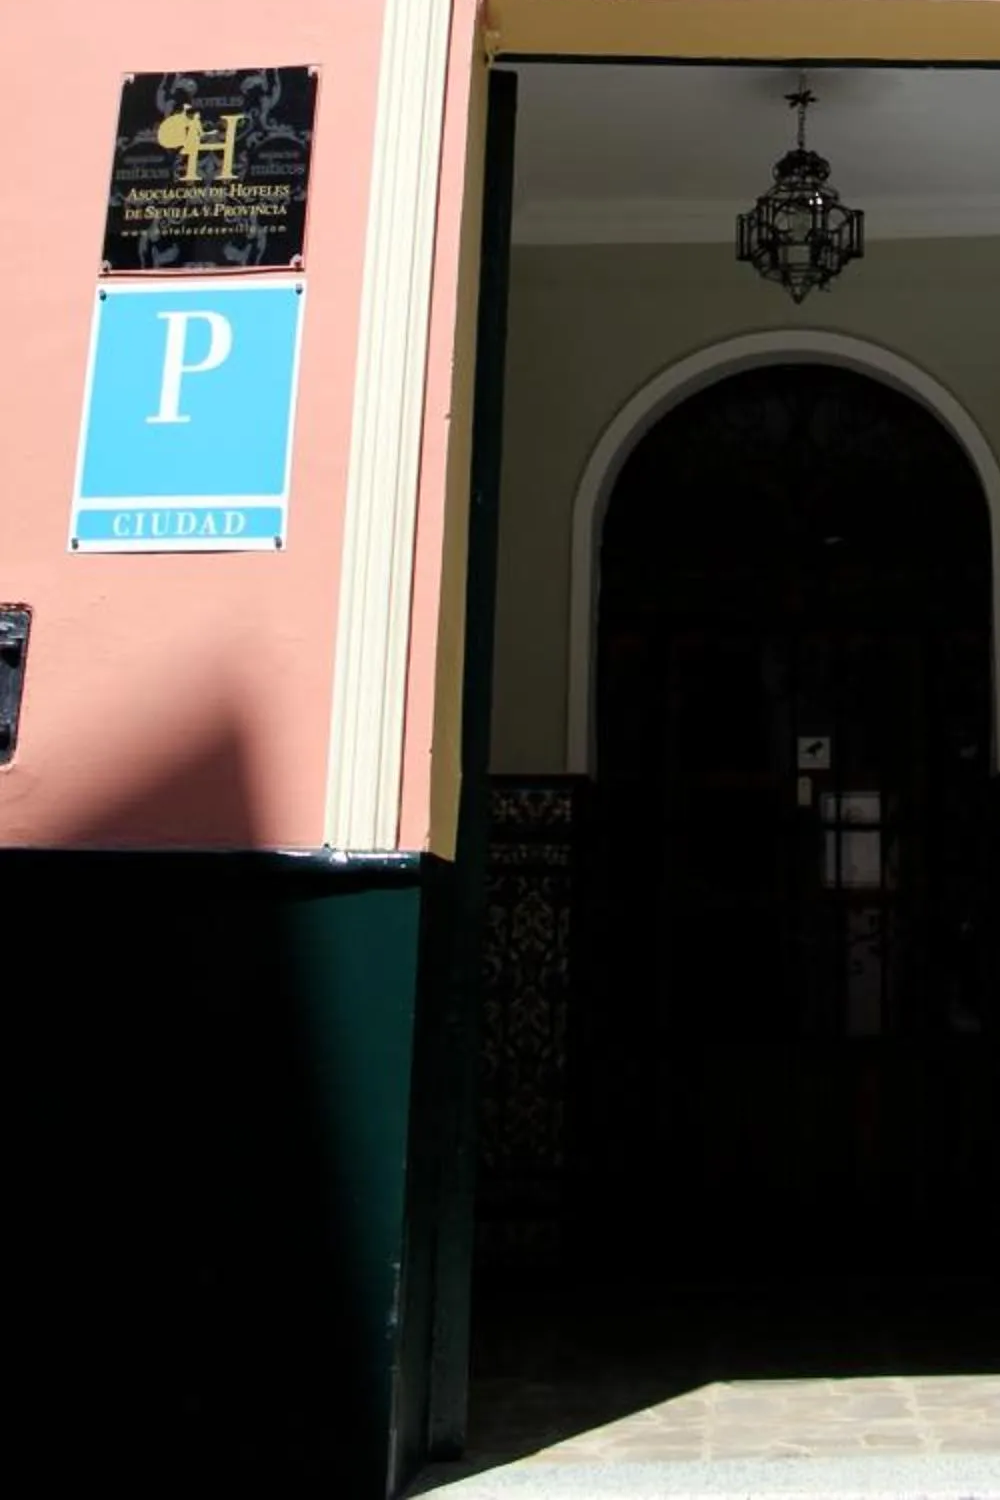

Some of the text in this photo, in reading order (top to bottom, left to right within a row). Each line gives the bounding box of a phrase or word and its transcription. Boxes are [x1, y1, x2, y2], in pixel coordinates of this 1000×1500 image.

[228, 183, 290, 198] HOTELES
[143, 205, 200, 219] SEVILLA
[213, 202, 288, 218] PROVINCIA
[145, 310, 233, 424] P
[112, 510, 246, 537] CIUDAD
